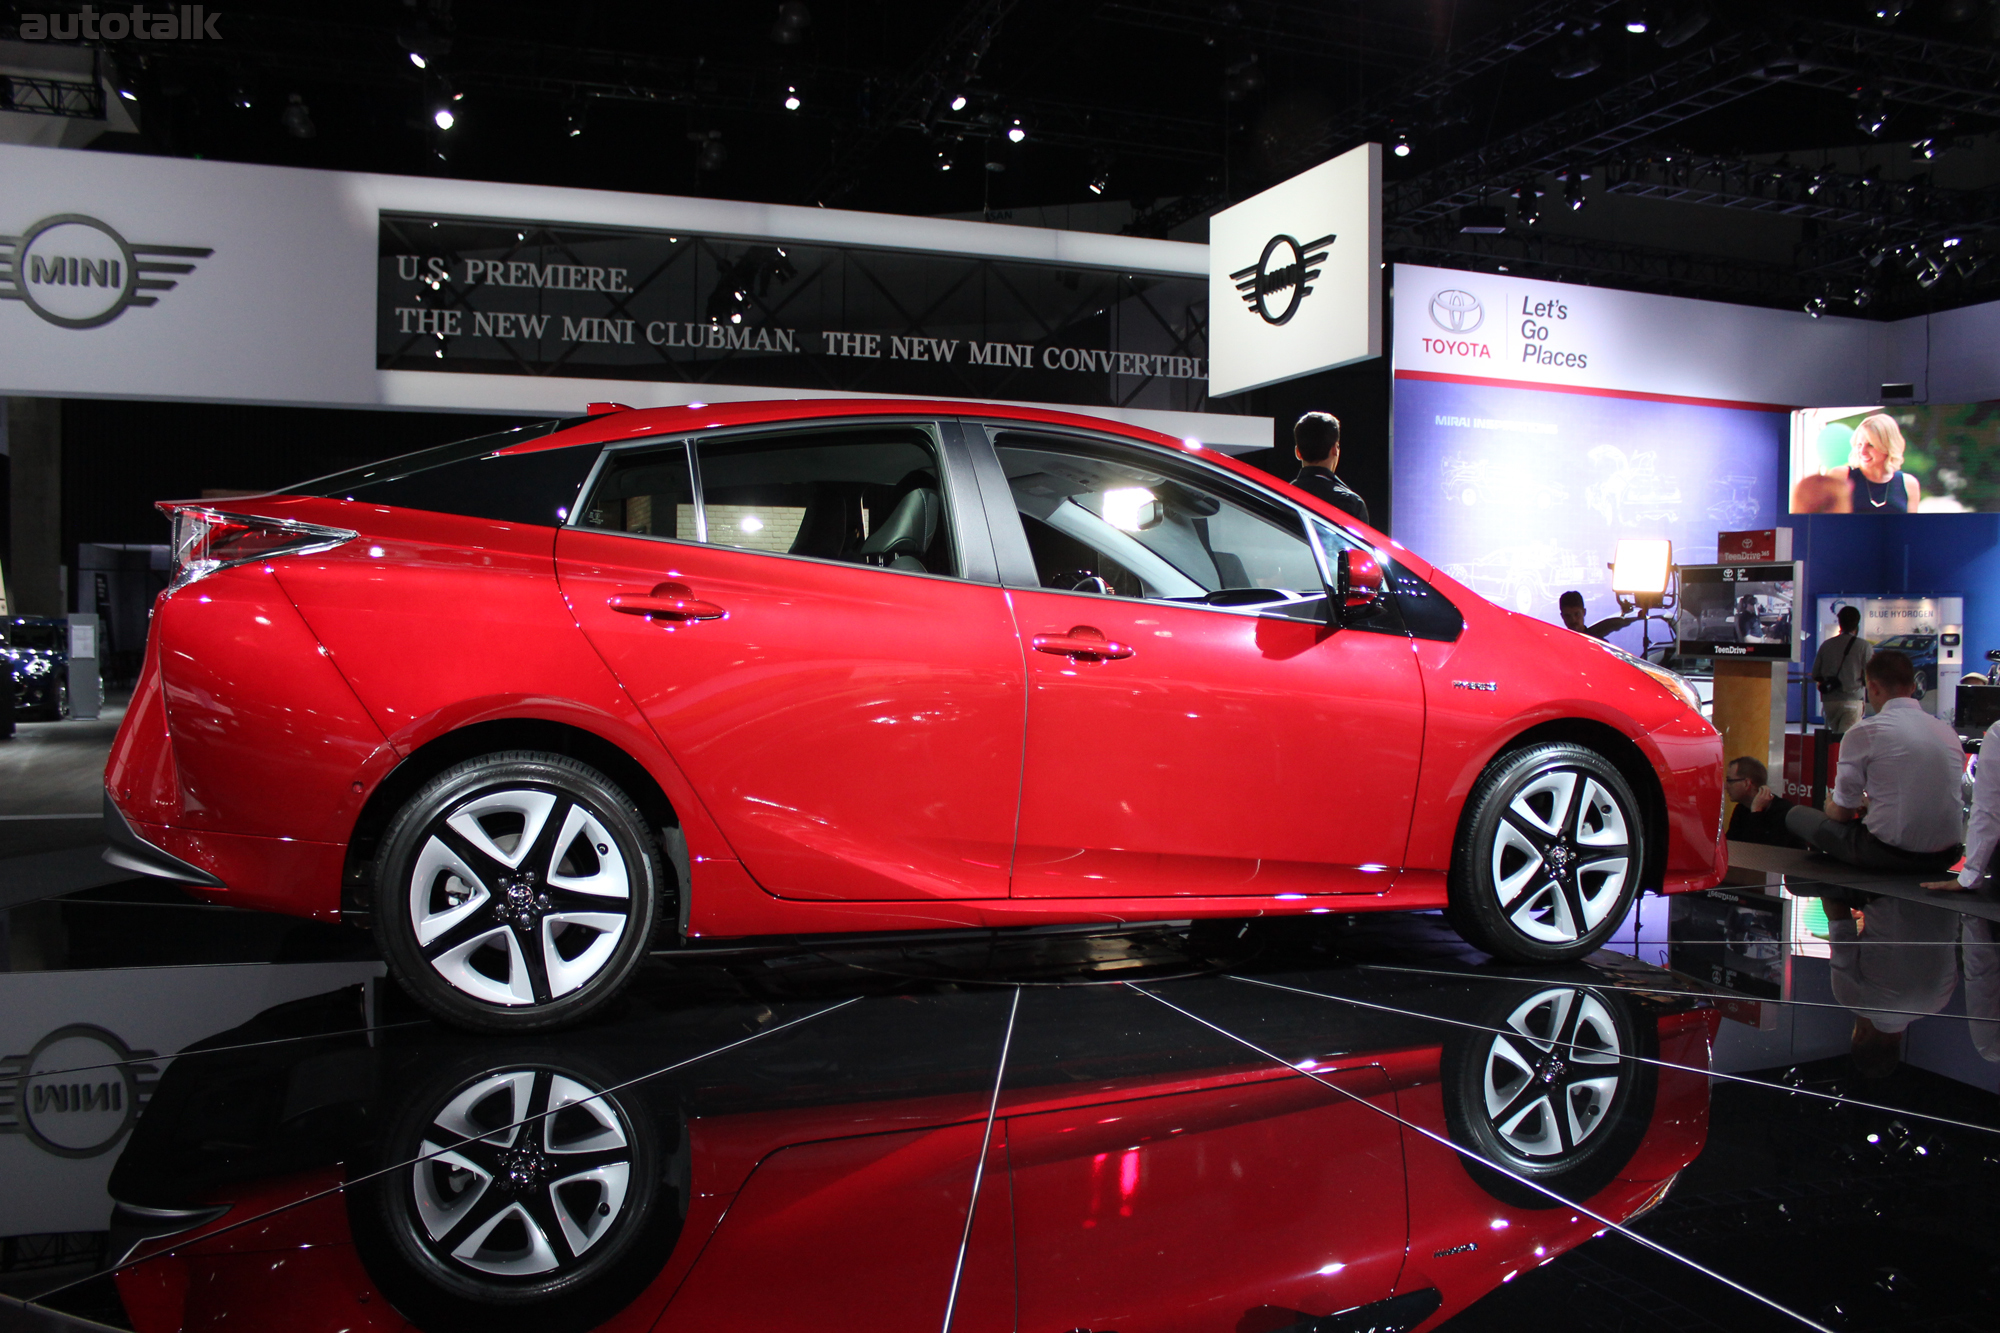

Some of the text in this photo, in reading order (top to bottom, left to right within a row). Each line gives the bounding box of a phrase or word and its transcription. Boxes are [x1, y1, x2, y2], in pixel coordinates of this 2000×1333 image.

[31, 255, 120, 289] MINI
[396, 255, 634, 293] U.S. PREMIERE.
[1522, 296, 1568, 319] Let's
[1521, 319, 1549, 341] Go
[395, 307, 1209, 381] THE NEW MINI CLUBMAN. THE NEW MINI CONVERTIBL
[1422, 338, 1491, 359] TOYOTA
[1522, 344, 1588, 368] Places
[1435, 415, 1470, 428] MIRAI
[1869, 610, 1934, 618] BLUE HYDROGEN
